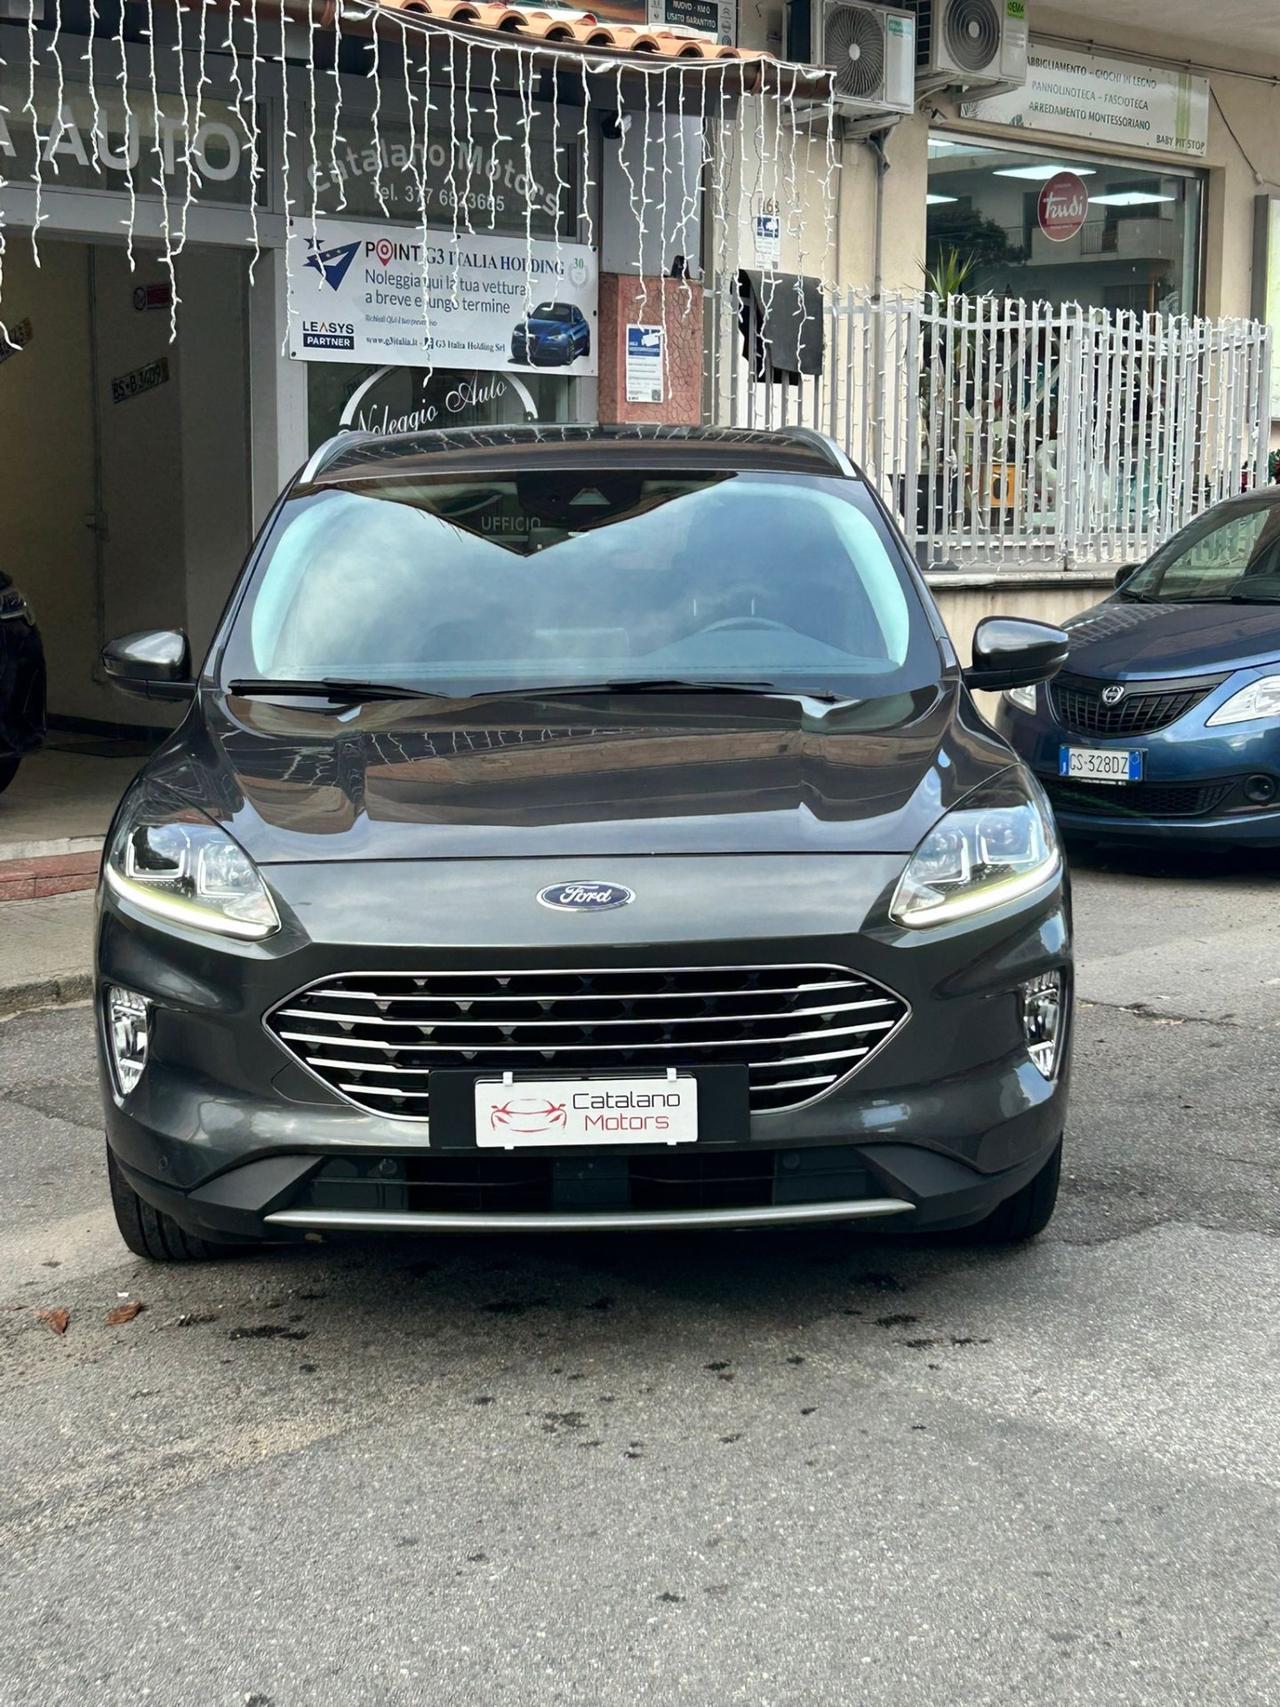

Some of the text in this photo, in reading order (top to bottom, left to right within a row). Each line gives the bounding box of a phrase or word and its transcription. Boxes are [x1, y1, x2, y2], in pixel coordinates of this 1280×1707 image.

[666, 11, 716, 29] USATO GARANTITO
[1026, 56, 1087, 76] ABBIGLIAMENTO
[1095, 69, 1122, 84] GIOCHI
[1132, 76, 1157, 89] LEGNO
[1031, 80, 1096, 101] PANNOLINOTECA
[1028, 101, 1151, 131] ARREDAMENTO MONTESSORIANO
[41, 104, 241, 181] AUTO
[1156, 134, 1205, 151] BABY PIT STOP
[307, 137, 557, 217] Catalano Motors
[365, 239, 421, 265] POINT
[427, 246, 445, 265] G3
[448, 250, 497, 270] ITALIA
[573, 257, 585, 270] 30
[365, 268, 421, 290] Noleggia
[459, 278, 480, 292] tua
[482, 280, 527, 297] vettura
[365, 293, 373, 305] a
[376, 290, 412, 307] breve
[414, 296, 422, 308] e
[462, 297, 511, 314] termine
[302, 320, 354, 335] LEASYS
[306, 335, 351, 347] PARTNER
[357, 372, 507, 435] Noleggio Auto
[480, 515, 541, 532] UFFICIO
[560, 885, 612, 903] Ford
[572, 1091, 681, 1110] Catalano
[584, 1112, 670, 1132] Motors
